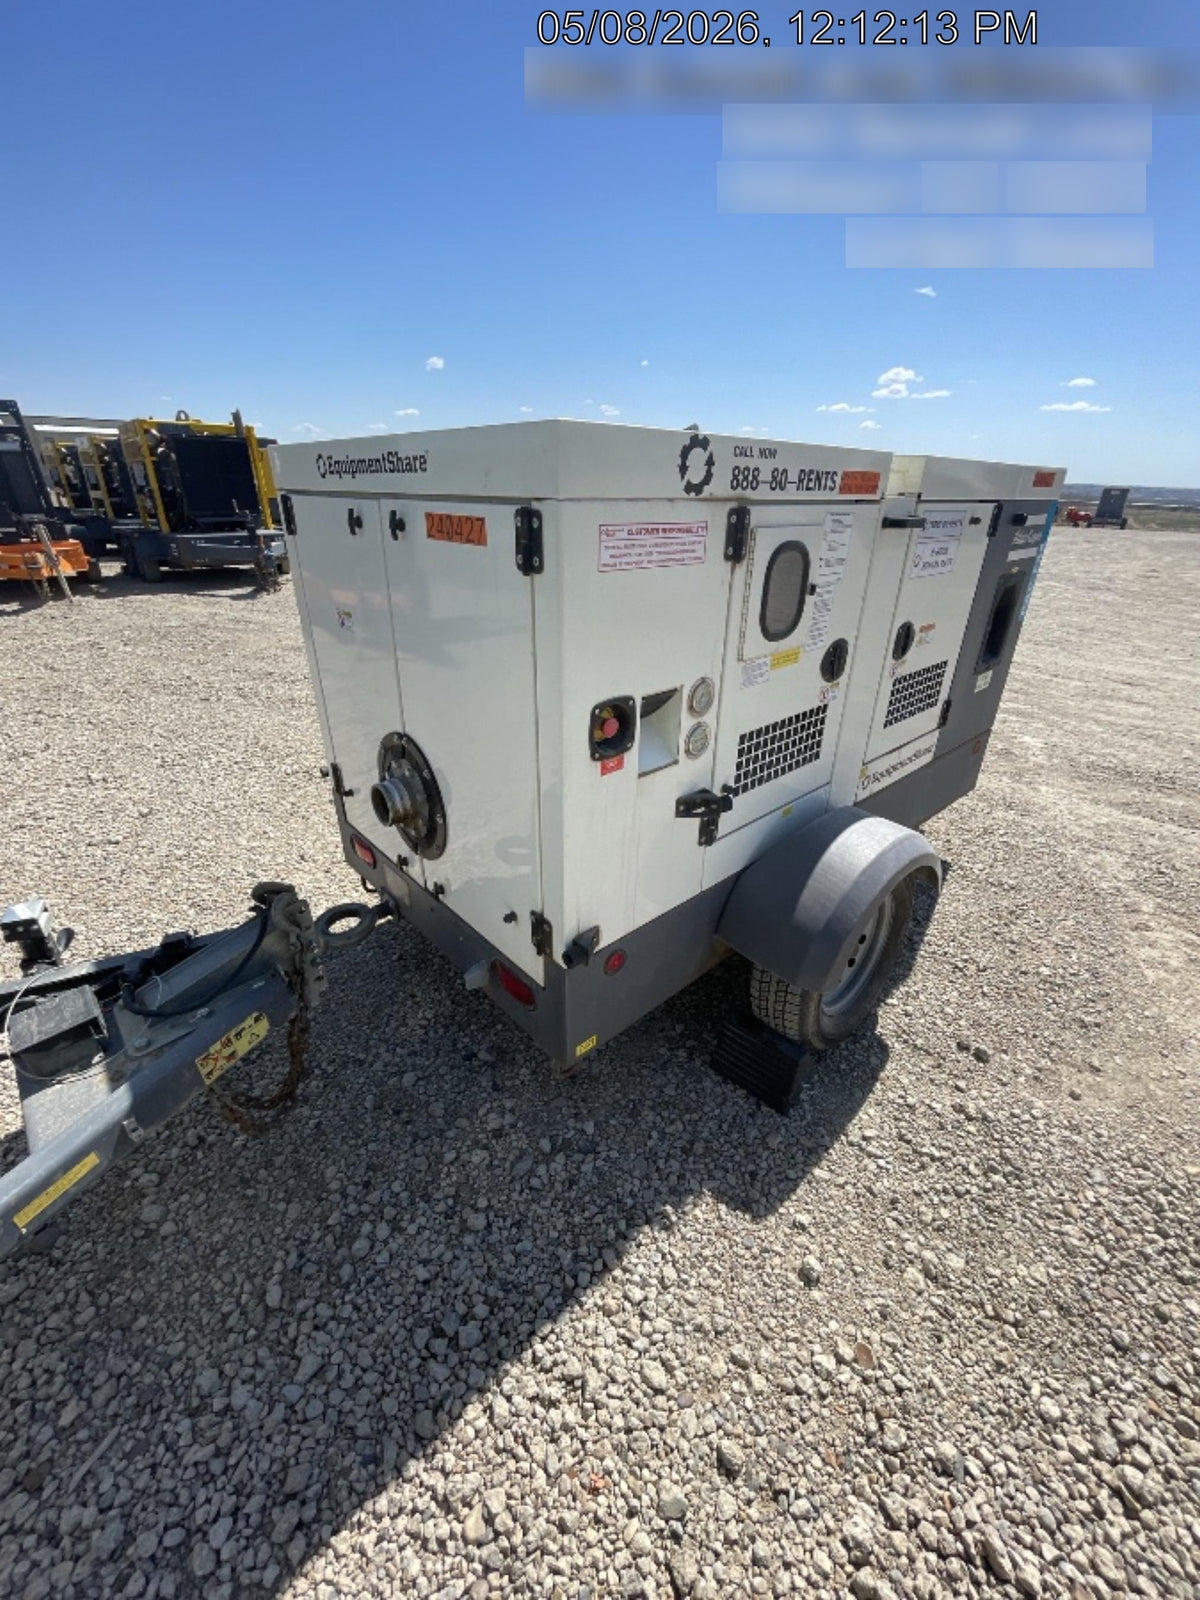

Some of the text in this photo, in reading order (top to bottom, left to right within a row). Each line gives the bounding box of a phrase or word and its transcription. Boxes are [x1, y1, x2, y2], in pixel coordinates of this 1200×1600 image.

[326, 450, 428, 479] EquipmentShare
[734, 446, 778, 459] CALL NOW
[730, 465, 838, 492] 888-80-RENTS
